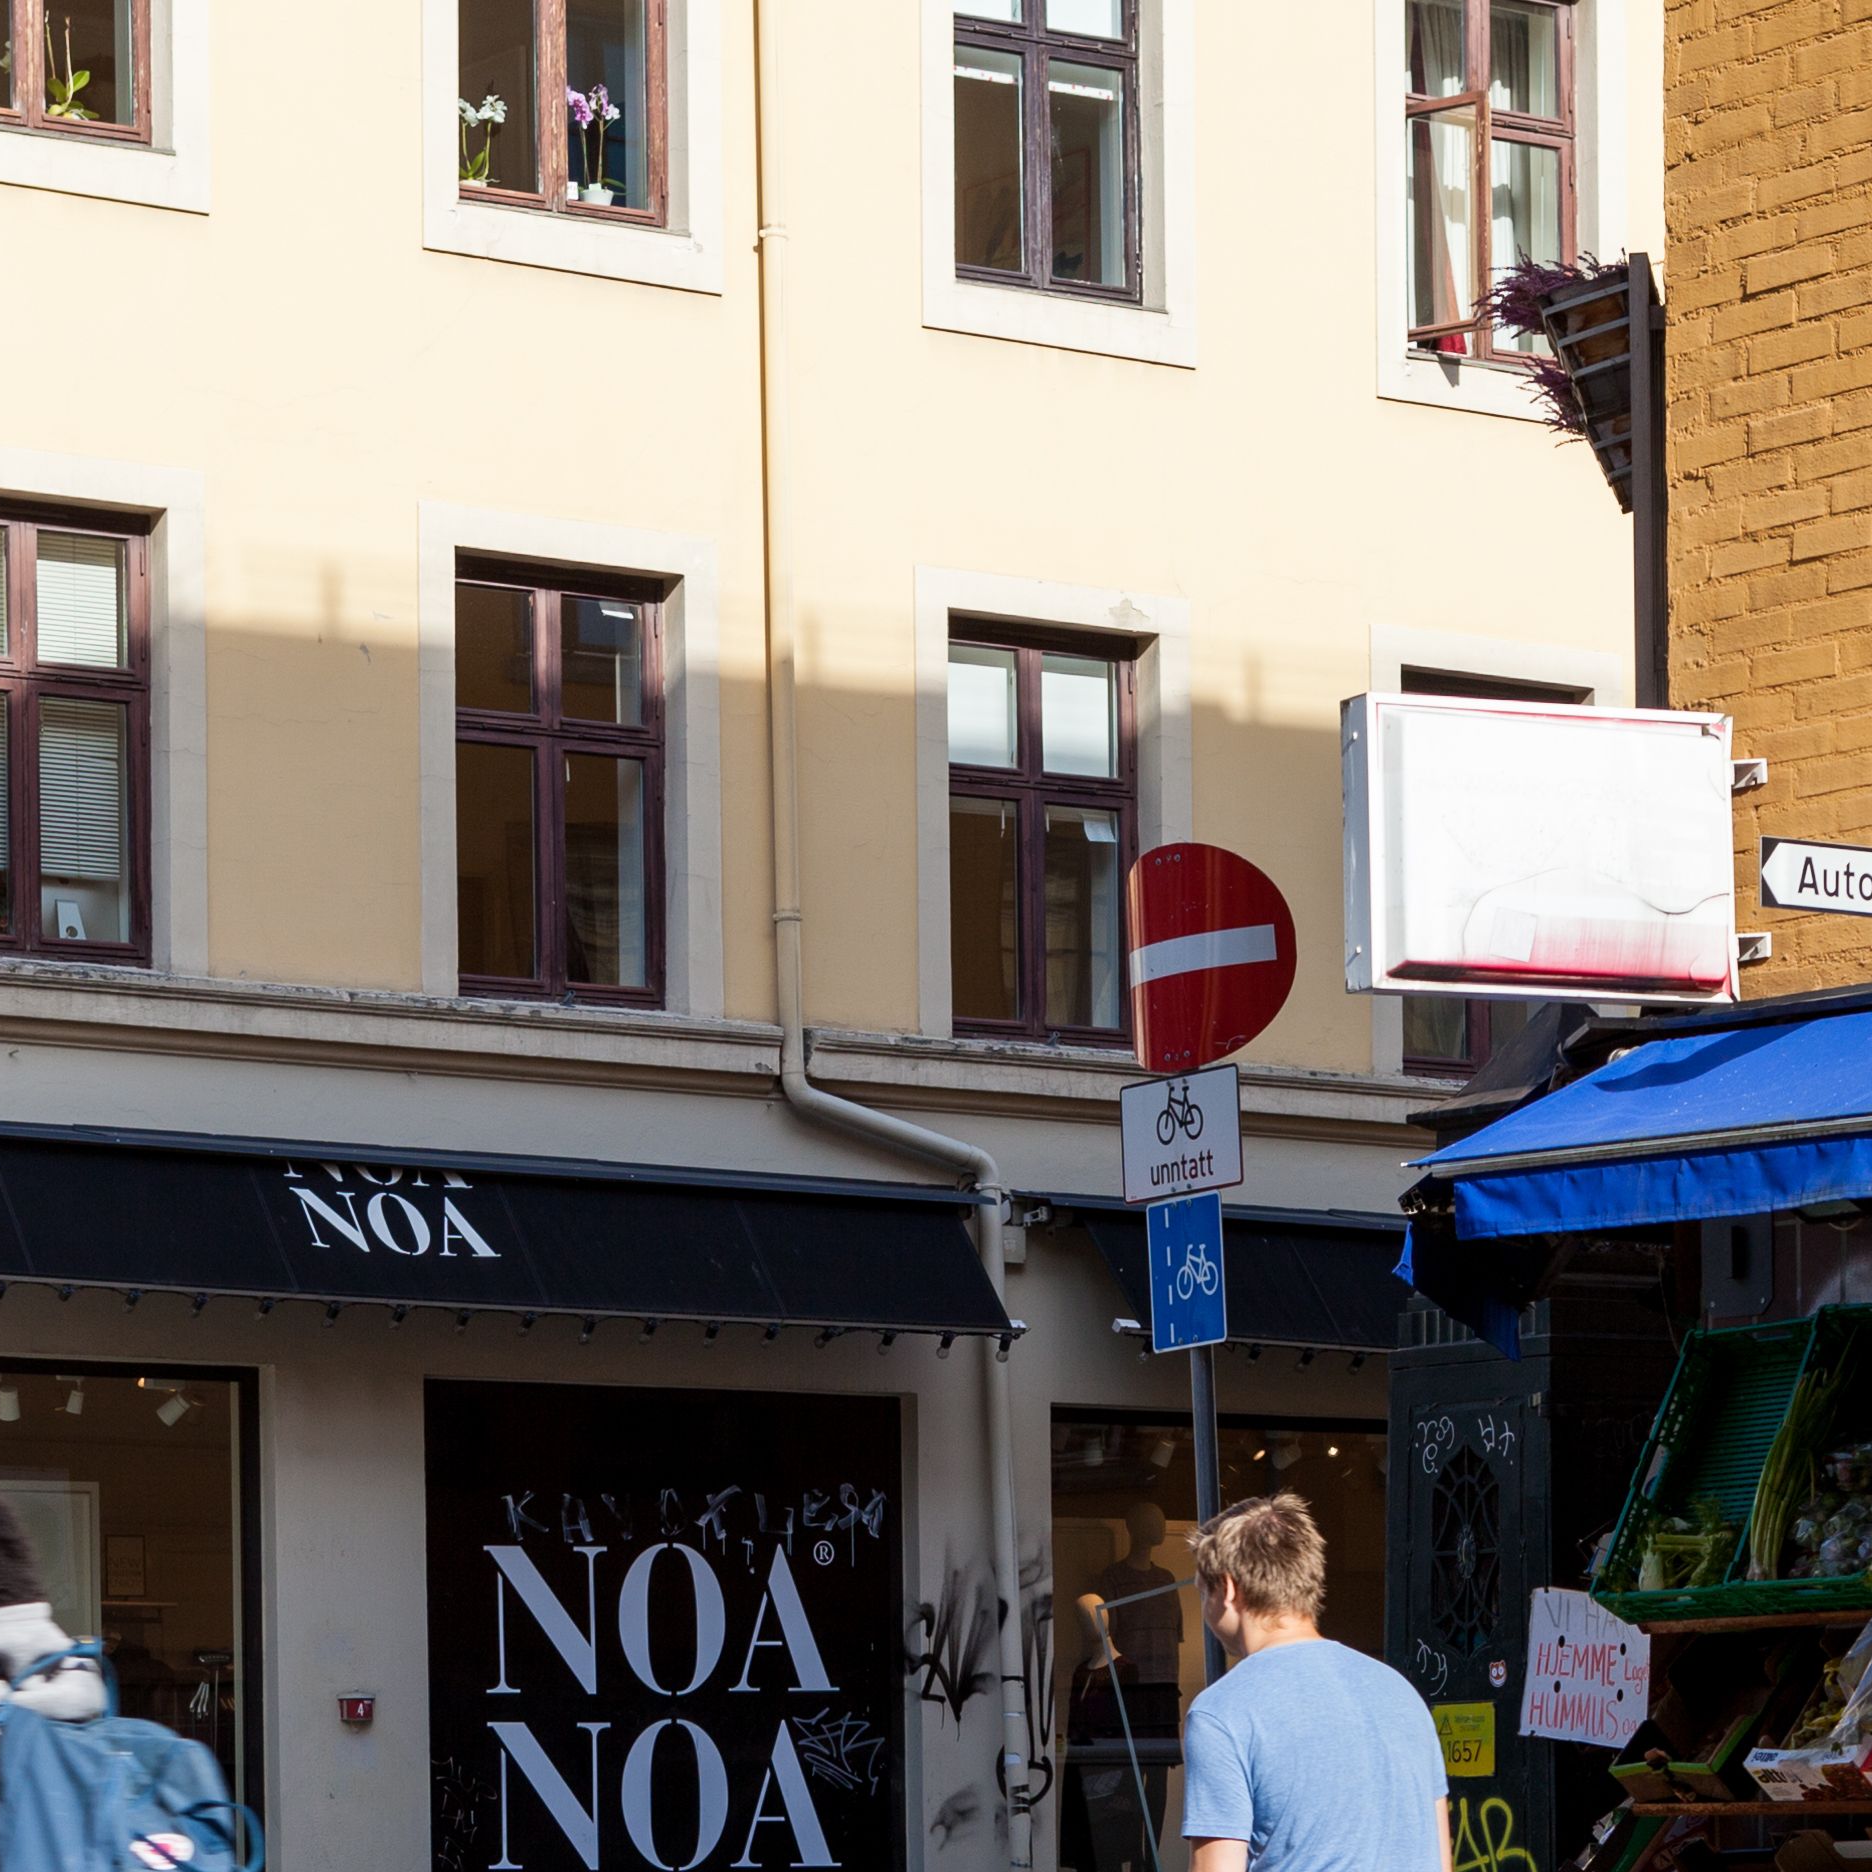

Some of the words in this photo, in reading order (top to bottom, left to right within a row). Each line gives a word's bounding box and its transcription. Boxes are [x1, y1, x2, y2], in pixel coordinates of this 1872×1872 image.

[1150, 1149, 1214, 1186] unntatt
[289, 1187, 502, 1257] NOA
[1536, 1642, 1618, 1687] HJEMME
[1530, 1692, 1619, 1740] HUMMUS
[486, 1718, 842, 1871] NOA
